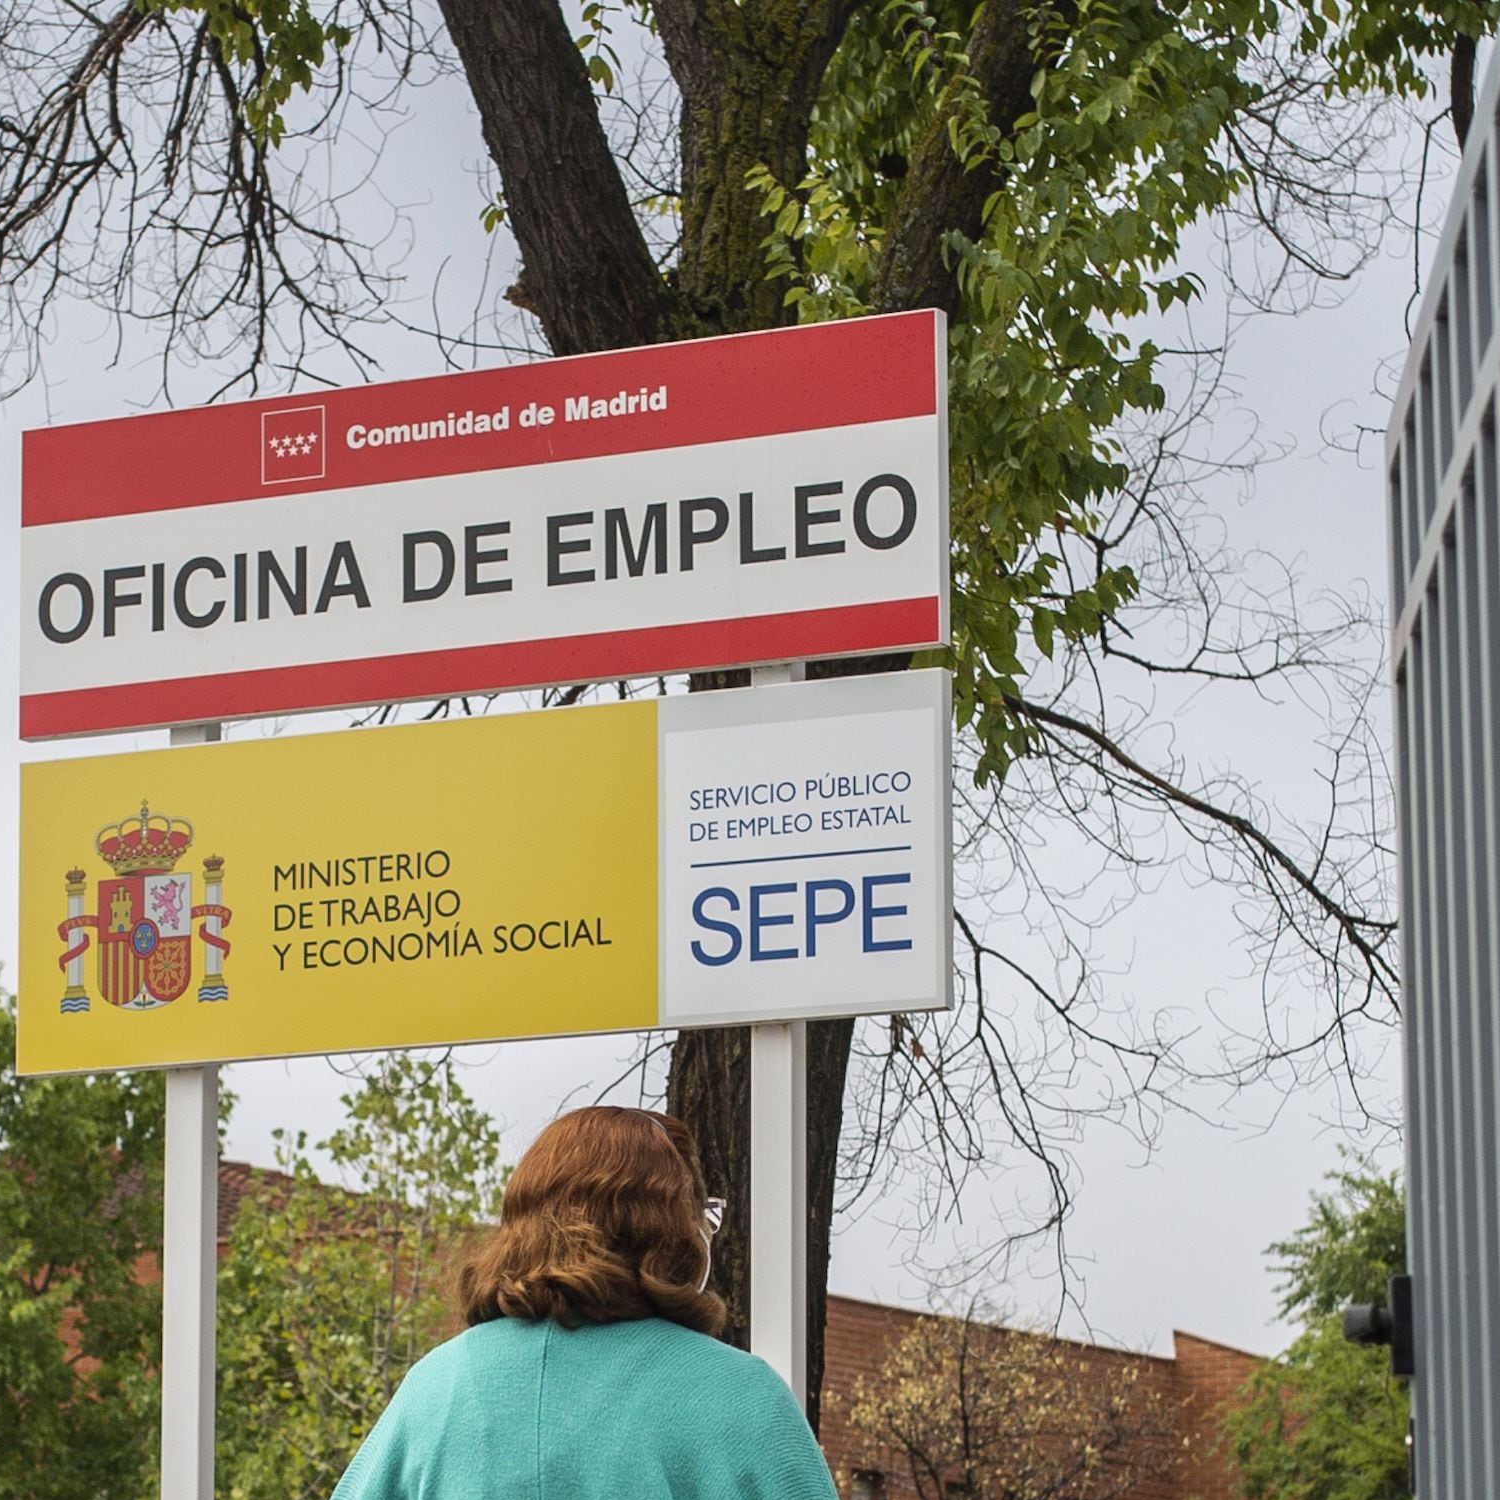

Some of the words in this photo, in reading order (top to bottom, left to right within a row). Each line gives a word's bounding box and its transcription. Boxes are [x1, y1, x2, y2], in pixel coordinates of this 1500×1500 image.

[346, 410, 509, 450] Comunidad
[518, 403, 555, 428] de
[564, 386, 668, 422] Madrid
[37, 540, 371, 645] OFICINA
[402, 521, 513, 603] DE
[546, 473, 918, 588] EMPLEO
[689, 782, 797, 811] SERVICIO
[805, 771, 912, 800] PÚBLICO
[689, 821, 719, 842] DE
[726, 813, 813, 839] EMPLEO
[821, 805, 912, 831] ESTATAL
[273, 850, 451, 892] MINISTERIO
[273, 902, 314, 932] DE
[319, 889, 461, 928] TRABAJO
[690, 872, 913, 967] SEPE
[272, 943, 292, 971] Y
[303, 921, 483, 969] ECONOMÍA
[493, 917, 612, 954] SOCIAL
